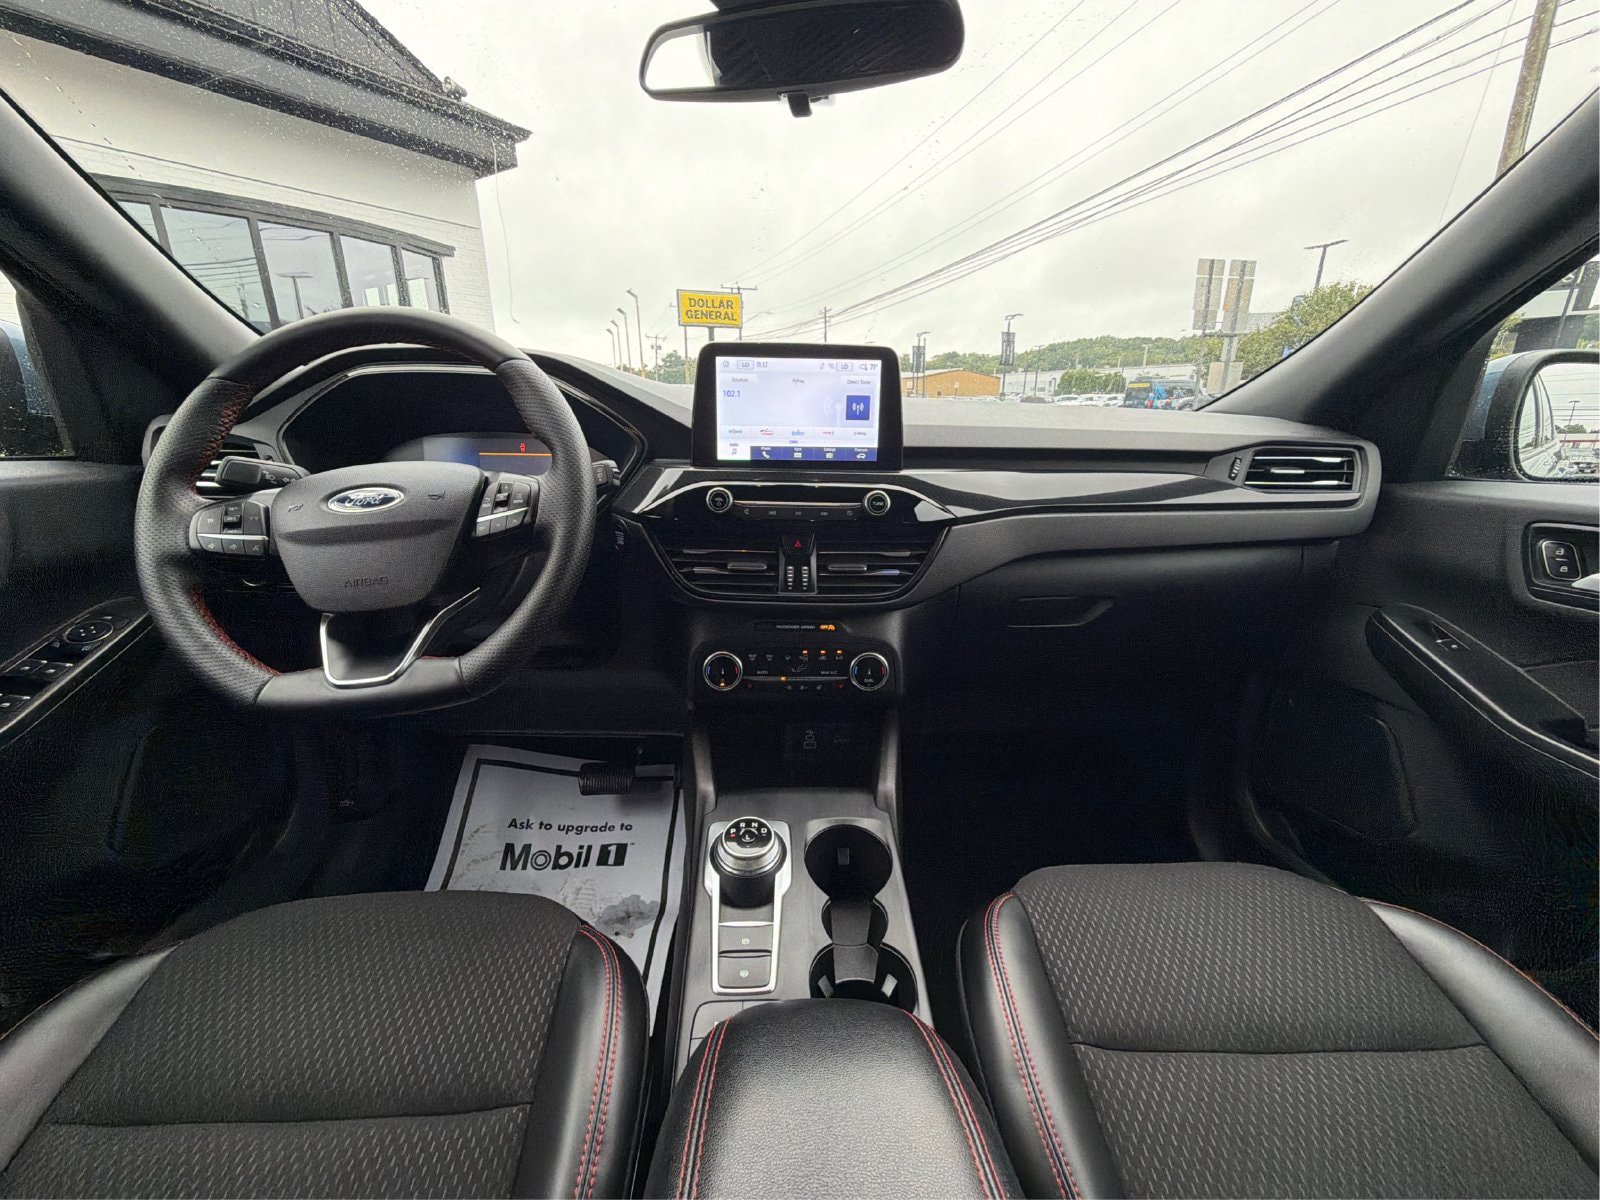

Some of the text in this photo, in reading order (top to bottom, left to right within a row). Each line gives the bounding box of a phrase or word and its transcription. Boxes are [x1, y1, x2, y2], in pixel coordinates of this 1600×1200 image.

[688, 297, 734, 309] DOLLAR
[685, 309, 737, 321] GENERAL
[722, 390, 741, 398] 102.1
[344, 492, 385, 507] Ford
[344, 576, 389, 588] AIRBAG
[507, 817, 633, 835] Ask to upgrade to
[499, 843, 593, 871] Mobil
